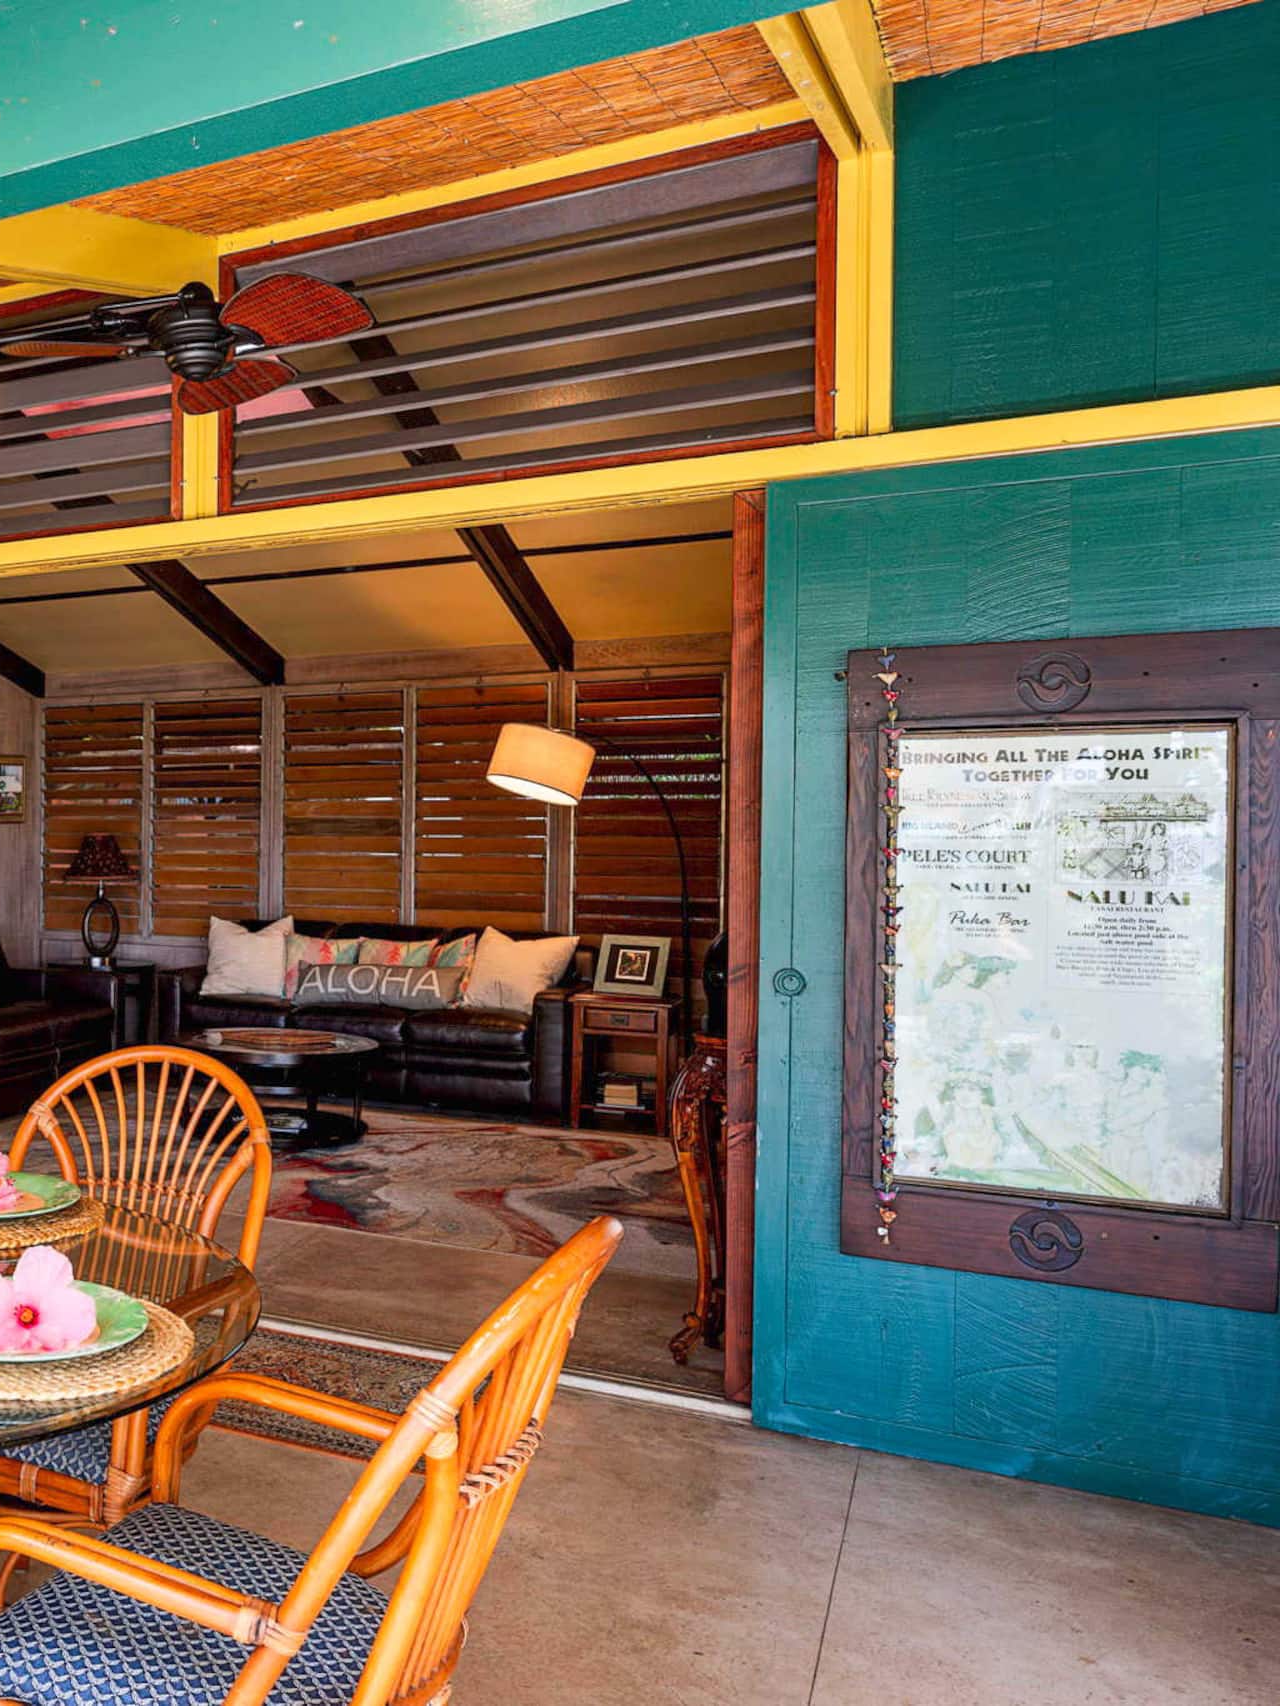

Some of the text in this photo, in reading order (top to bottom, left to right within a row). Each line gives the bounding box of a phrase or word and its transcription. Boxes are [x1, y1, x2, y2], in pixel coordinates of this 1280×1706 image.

[902, 751, 988, 764] BRINGING
[995, 749, 1028, 762] ALL
[1034, 749, 1069, 761] THE
[965, 850, 1032, 863] COURT
[1066, 890, 1190, 905] NALU KAI
[996, 911, 1031, 926] Bar
[298, 965, 441, 998] ALOHA
